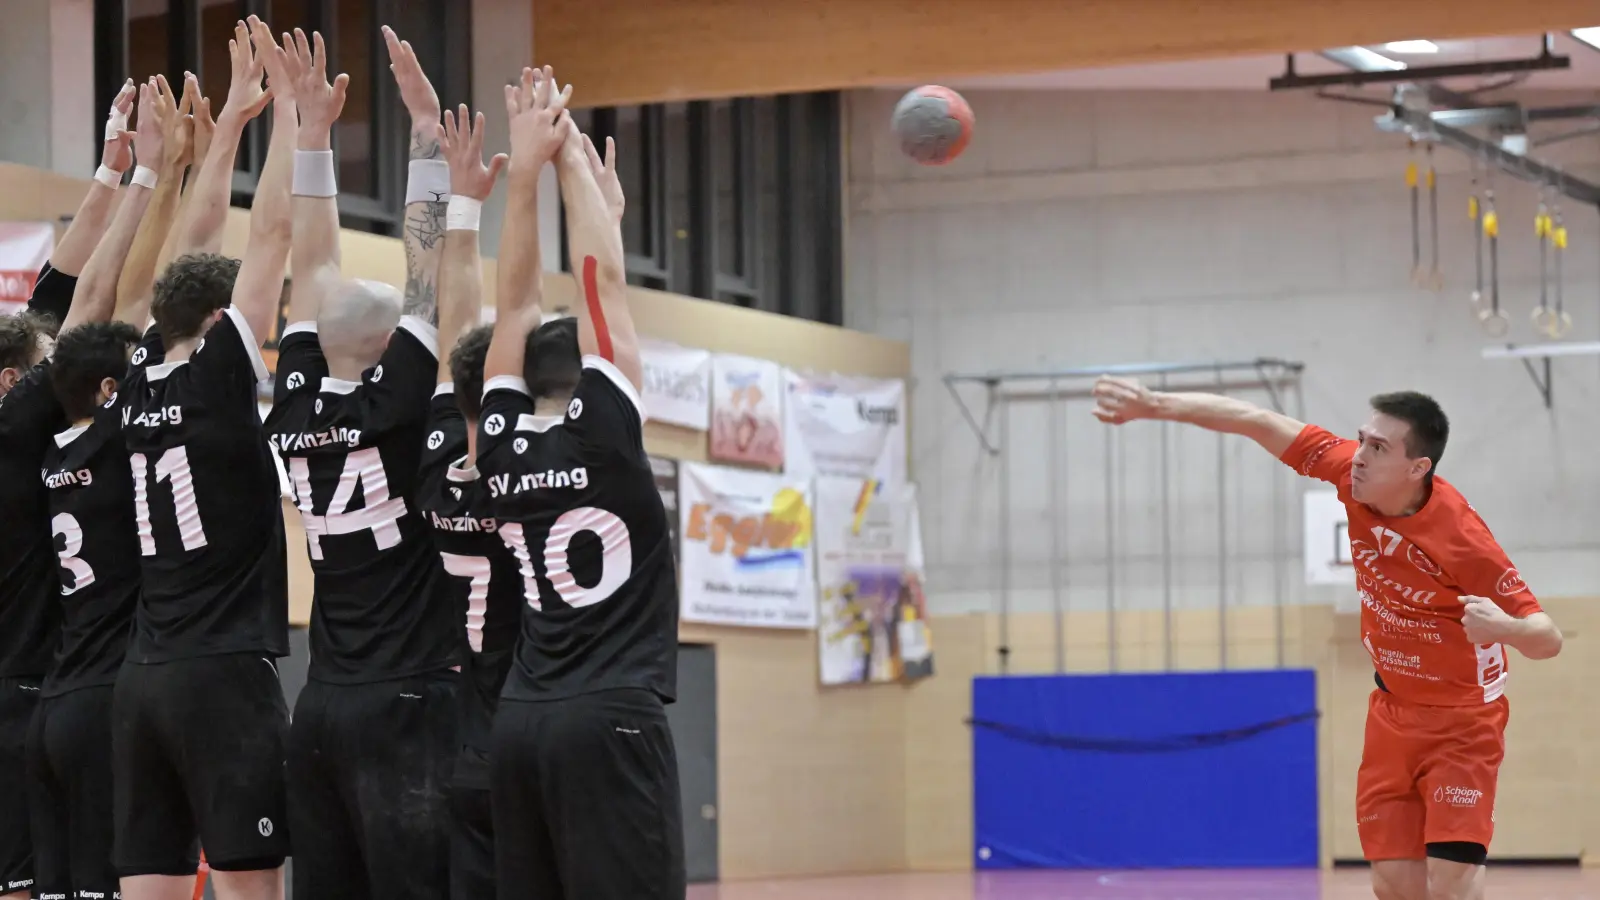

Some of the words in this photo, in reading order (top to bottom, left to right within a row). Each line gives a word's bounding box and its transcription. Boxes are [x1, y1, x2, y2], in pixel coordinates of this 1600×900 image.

[488, 473, 509, 498] SV
[130, 445, 208, 556] 11
[431, 511, 497, 533] Anzing
[52, 512, 96, 596] 3
[498, 507, 632, 611] 10
[440, 551, 491, 652] 7
[1445, 785, 1483, 798] Schöppe
[1451, 793, 1478, 805] Knoll
[8, 879, 33, 889] Kempa
[80, 890, 104, 899] Kempa
